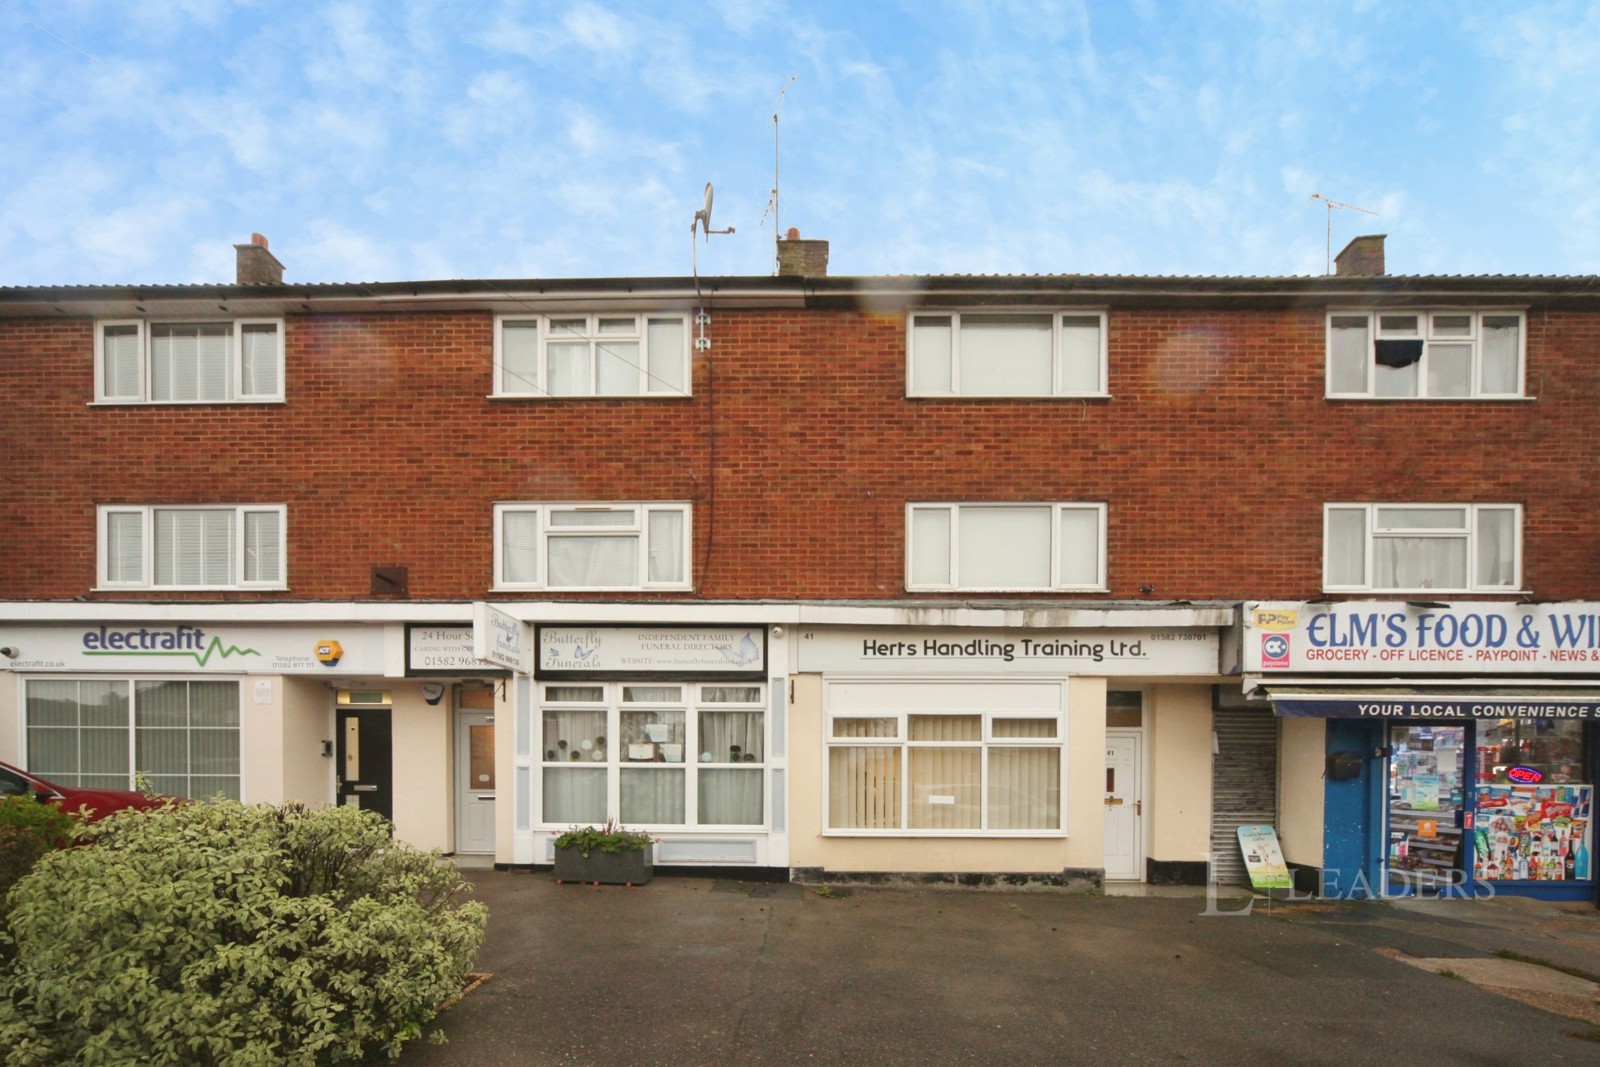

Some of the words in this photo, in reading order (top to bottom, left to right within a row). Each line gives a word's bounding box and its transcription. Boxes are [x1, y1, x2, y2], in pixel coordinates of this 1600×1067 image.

[422, 631, 433, 640] 24
[436, 631, 462, 640] Hour
[638, 633, 702, 641] INDEPENDENT
[703, 633, 735, 641] FAMILY
[1150, 633, 1175, 641] 01582
[1178, 633, 1207, 641] 730701
[1306, 613, 1407, 648] ELM'S
[1416, 613, 1508, 648] FOOD
[1516, 614, 1541, 648] &
[1547, 614, 1600, 648] WI
[82, 625, 205, 650] electrafit
[543, 630, 602, 649] Butterfly
[863, 639, 917, 656] Herts
[923, 639, 1015, 662] Handling
[1021, 639, 1104, 662] Training
[1110, 639, 1147, 656] Ltd.
[1306, 649, 1369, 661] GROCERY
[1380, 649, 1405, 661] OFF
[1409, 649, 1464, 661] LICENCE
[1476, 649, 1539, 661] PAYPOINT
[1550, 649, 1587, 661] NEWS
[424, 656, 455, 666] 01582
[545, 655, 601, 668] Funerals
[1358, 704, 1404, 717] YOUR
[1411, 704, 1466, 717] LOCAL
[1472, 705, 1589, 718] CONVENIENCE
[1508, 769, 1542, 783] OPEN
